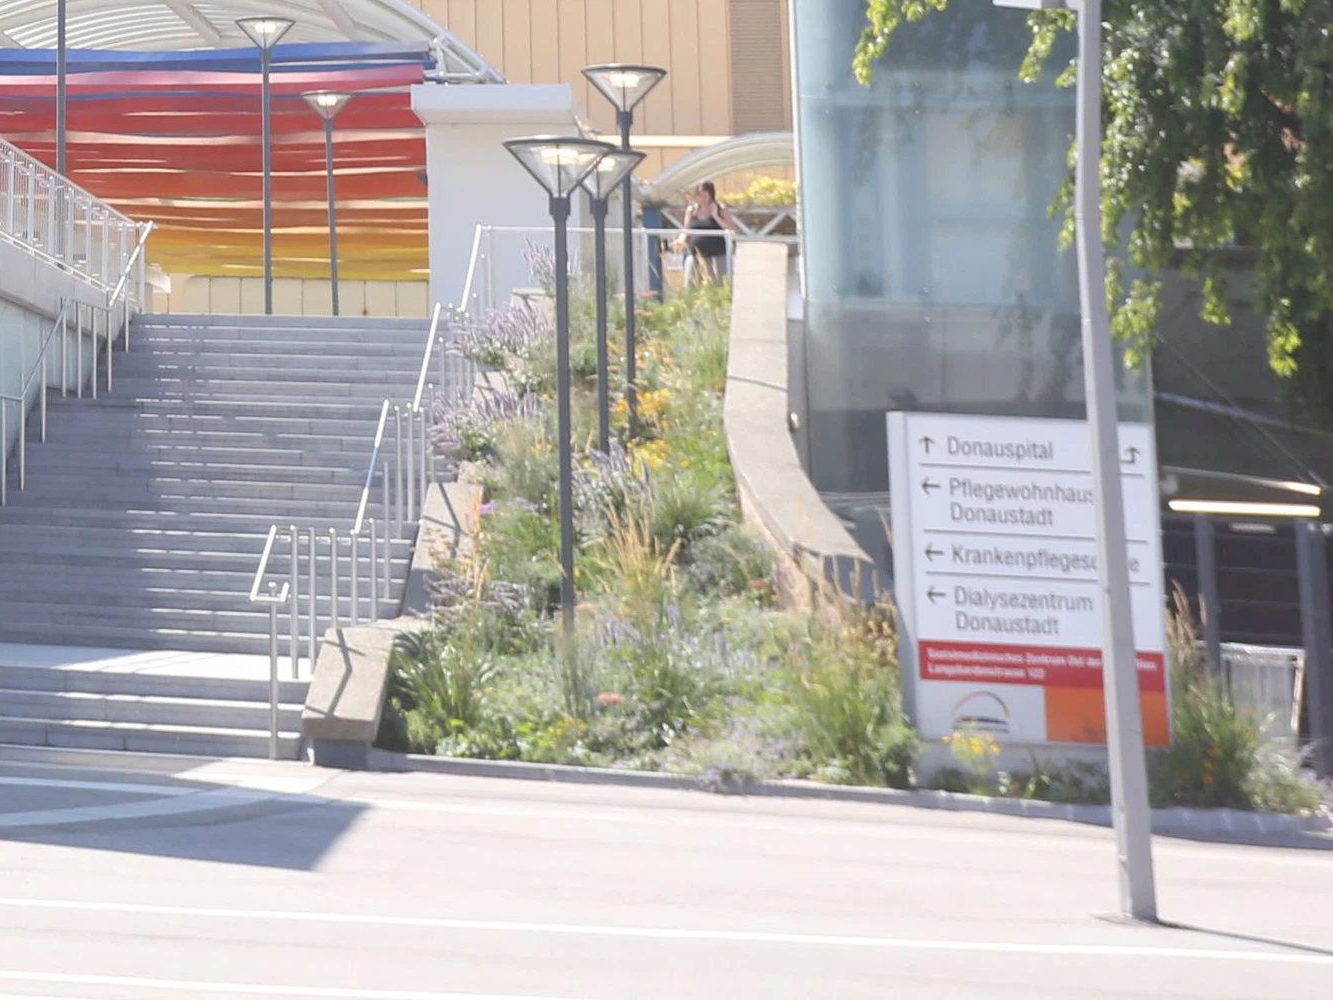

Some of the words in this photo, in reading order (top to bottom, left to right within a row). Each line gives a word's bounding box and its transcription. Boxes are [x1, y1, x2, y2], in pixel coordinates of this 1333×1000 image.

[947, 435, 1054, 462] Donauspital
[950, 502, 1054, 526] Donaustadt
[954, 585, 1094, 612] Dialysezentrum
[956, 611, 1061, 636] Donaustadt
